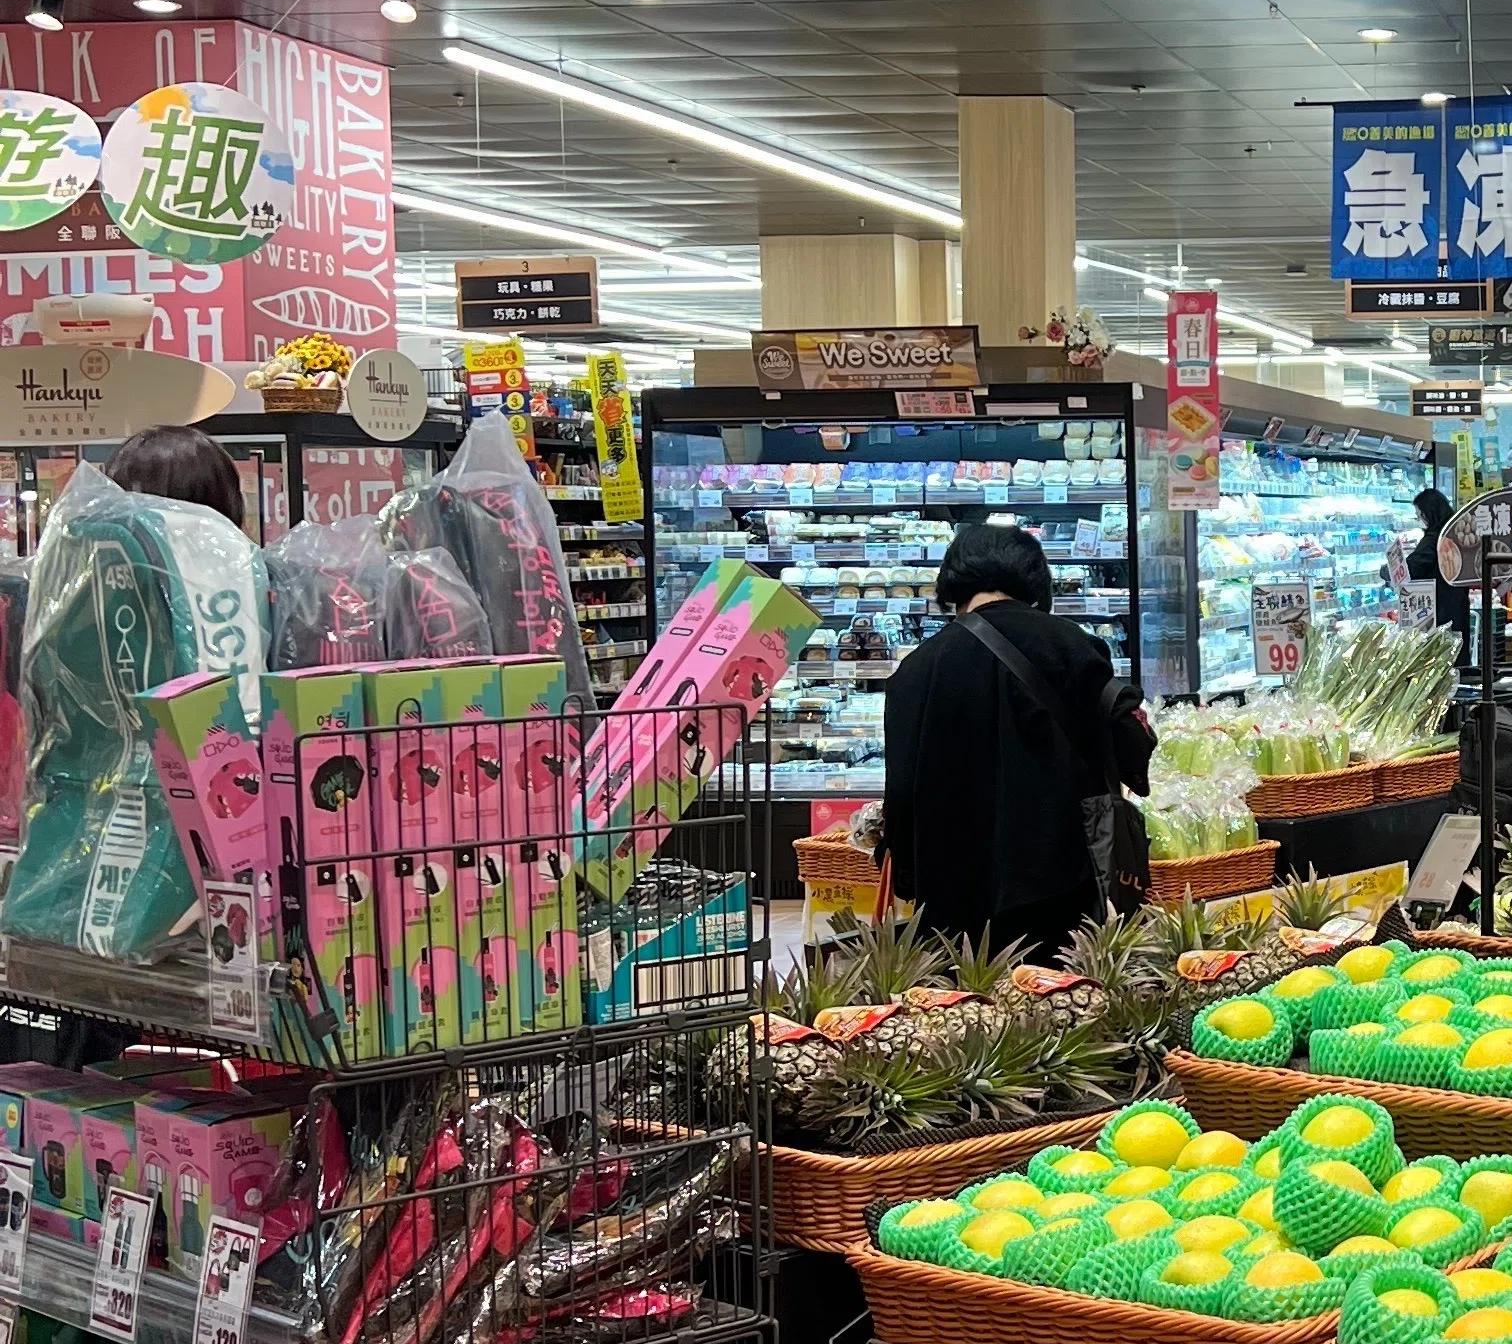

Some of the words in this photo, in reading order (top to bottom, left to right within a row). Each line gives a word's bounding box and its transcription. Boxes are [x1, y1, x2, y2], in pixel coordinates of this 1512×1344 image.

[123, 106, 266, 238] 趣
[335, 60, 389, 300] BAKERY
[0, 255, 224, 296] MILES
[252, 247, 335, 277] SWEETS
[522, 261, 529, 272] 3
[819, 342, 864, 367] We
[869, 341, 953, 365] Sweet
[16, 368, 103, 410] Hankyu
[365, 360, 410, 396] Hankyu
[28, 413, 96, 423] BAKERY
[1474, 503, 1511, 536] 急凍
[1269, 643, 1298, 672] 99
[214, 1135, 255, 1151] SQUID
